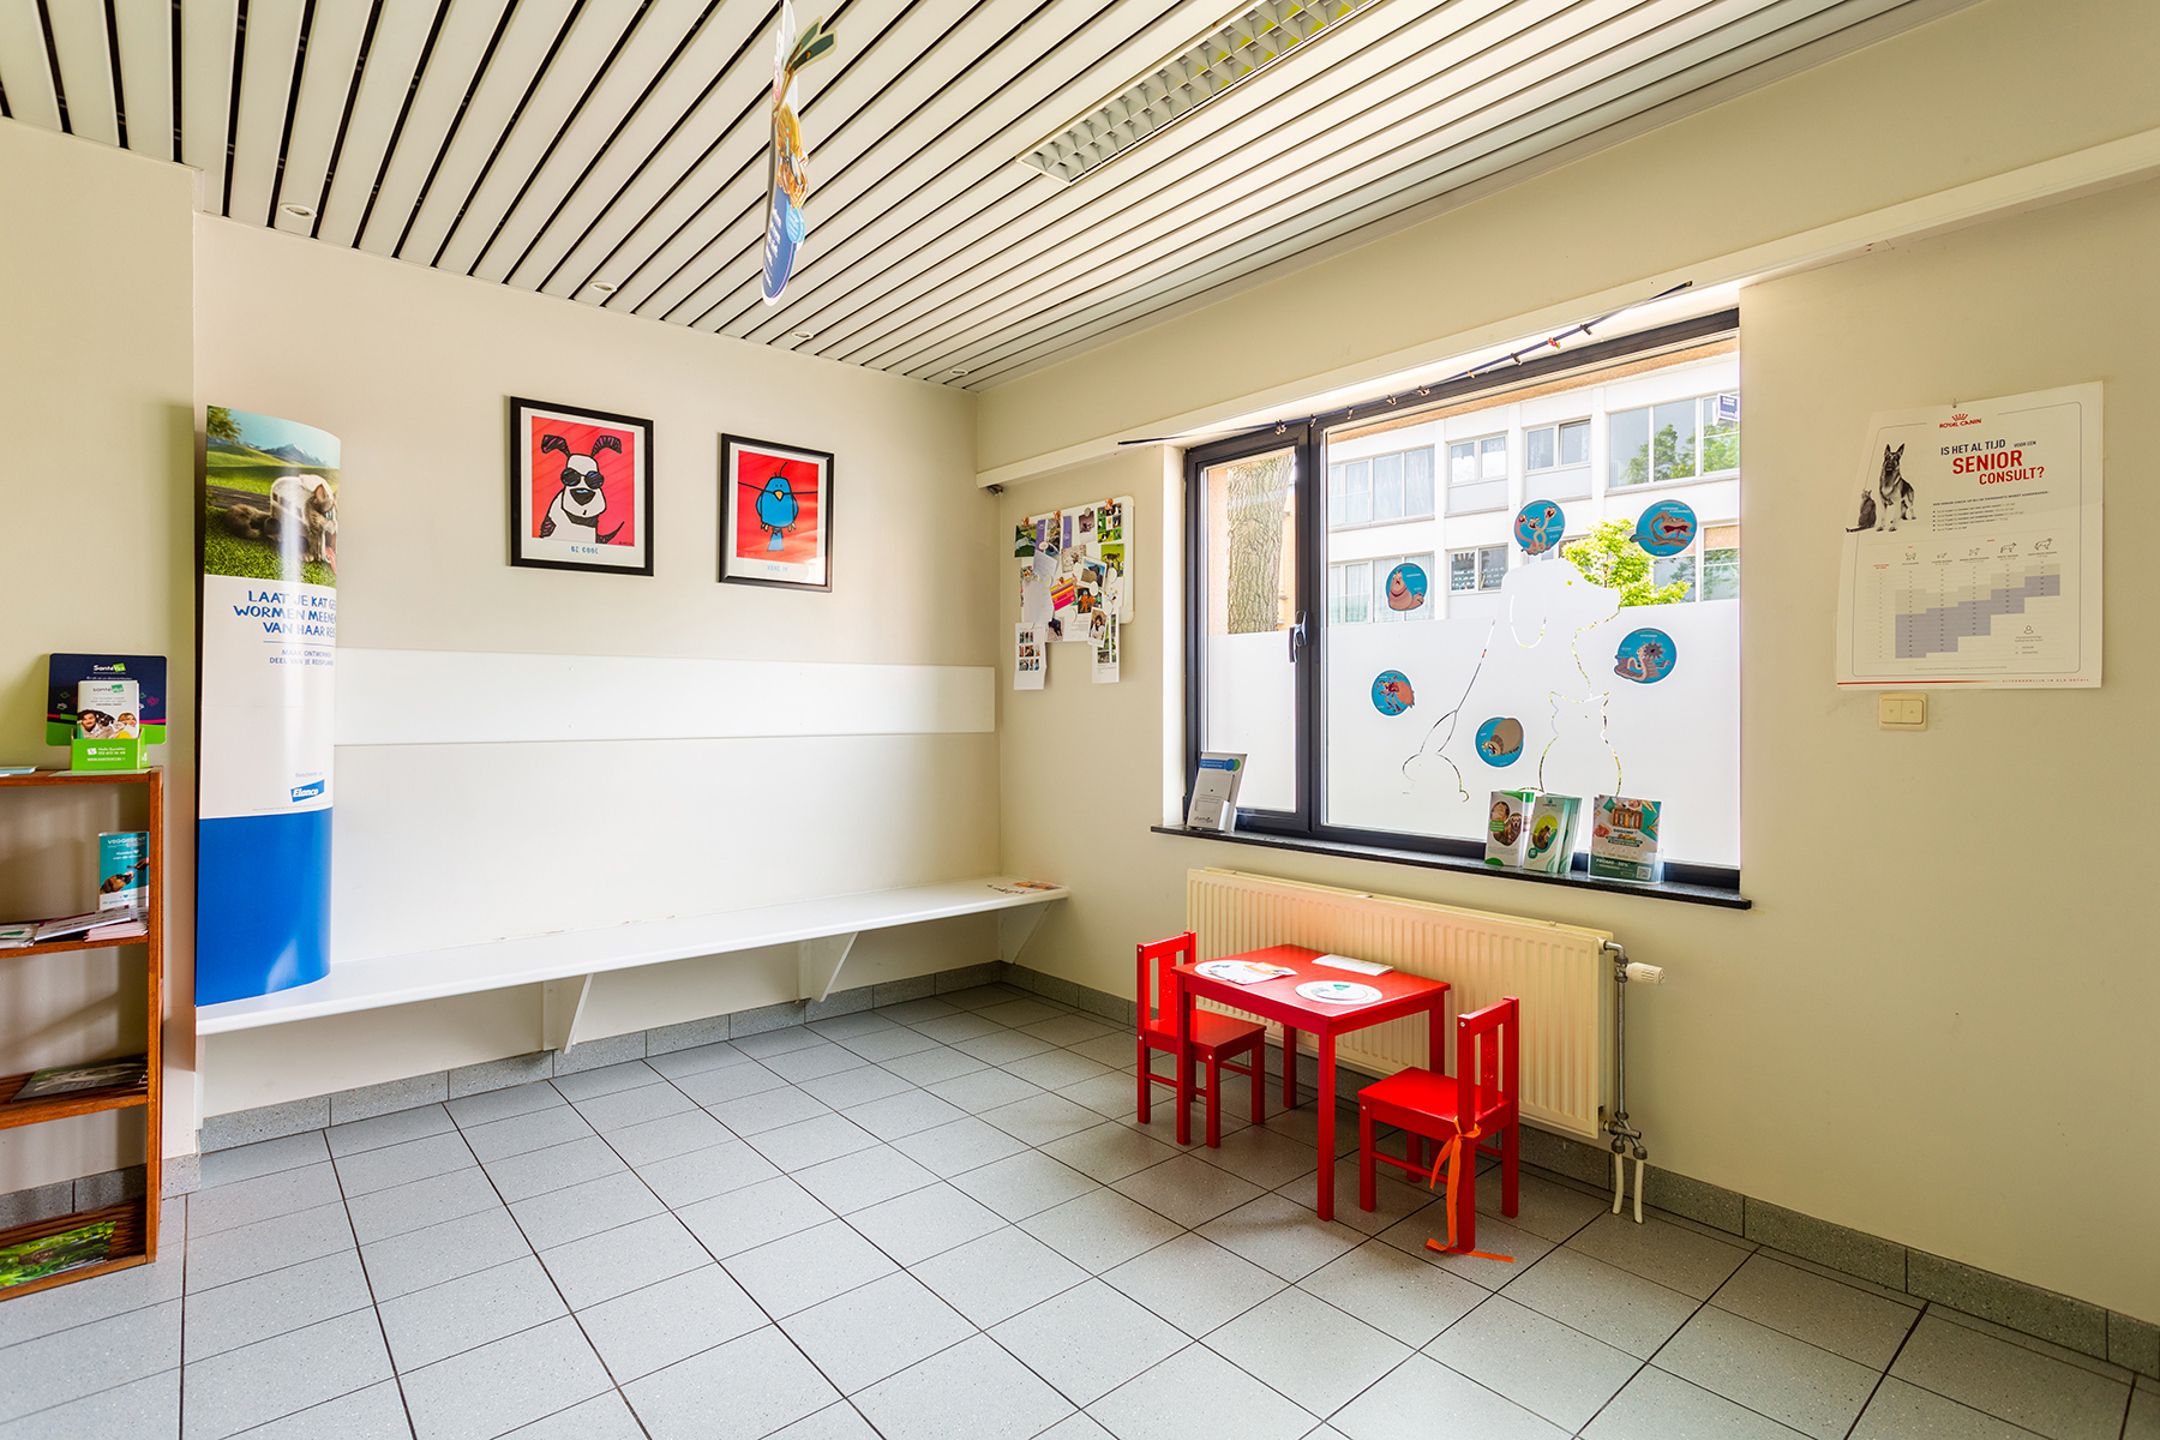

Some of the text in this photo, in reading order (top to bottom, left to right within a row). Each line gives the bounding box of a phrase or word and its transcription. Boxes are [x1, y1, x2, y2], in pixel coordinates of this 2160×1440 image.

[1960, 418, 1982, 426] CANIN
[1940, 446, 1950, 455] IS
[1951, 444, 1969, 454] HET
[1970, 442, 1982, 452] AL
[1985, 439, 2006, 450] TIJD
[1952, 449, 2023, 475] SENIOR
[1979, 466, 2045, 485] CONSULT?
[248, 590, 289, 604] LAAT
[311, 596, 328, 608] KAT
[233, 605, 305, 621] WORMEN
[263, 622, 293, 634] VAN
[297, 624, 325, 637] HAAR
